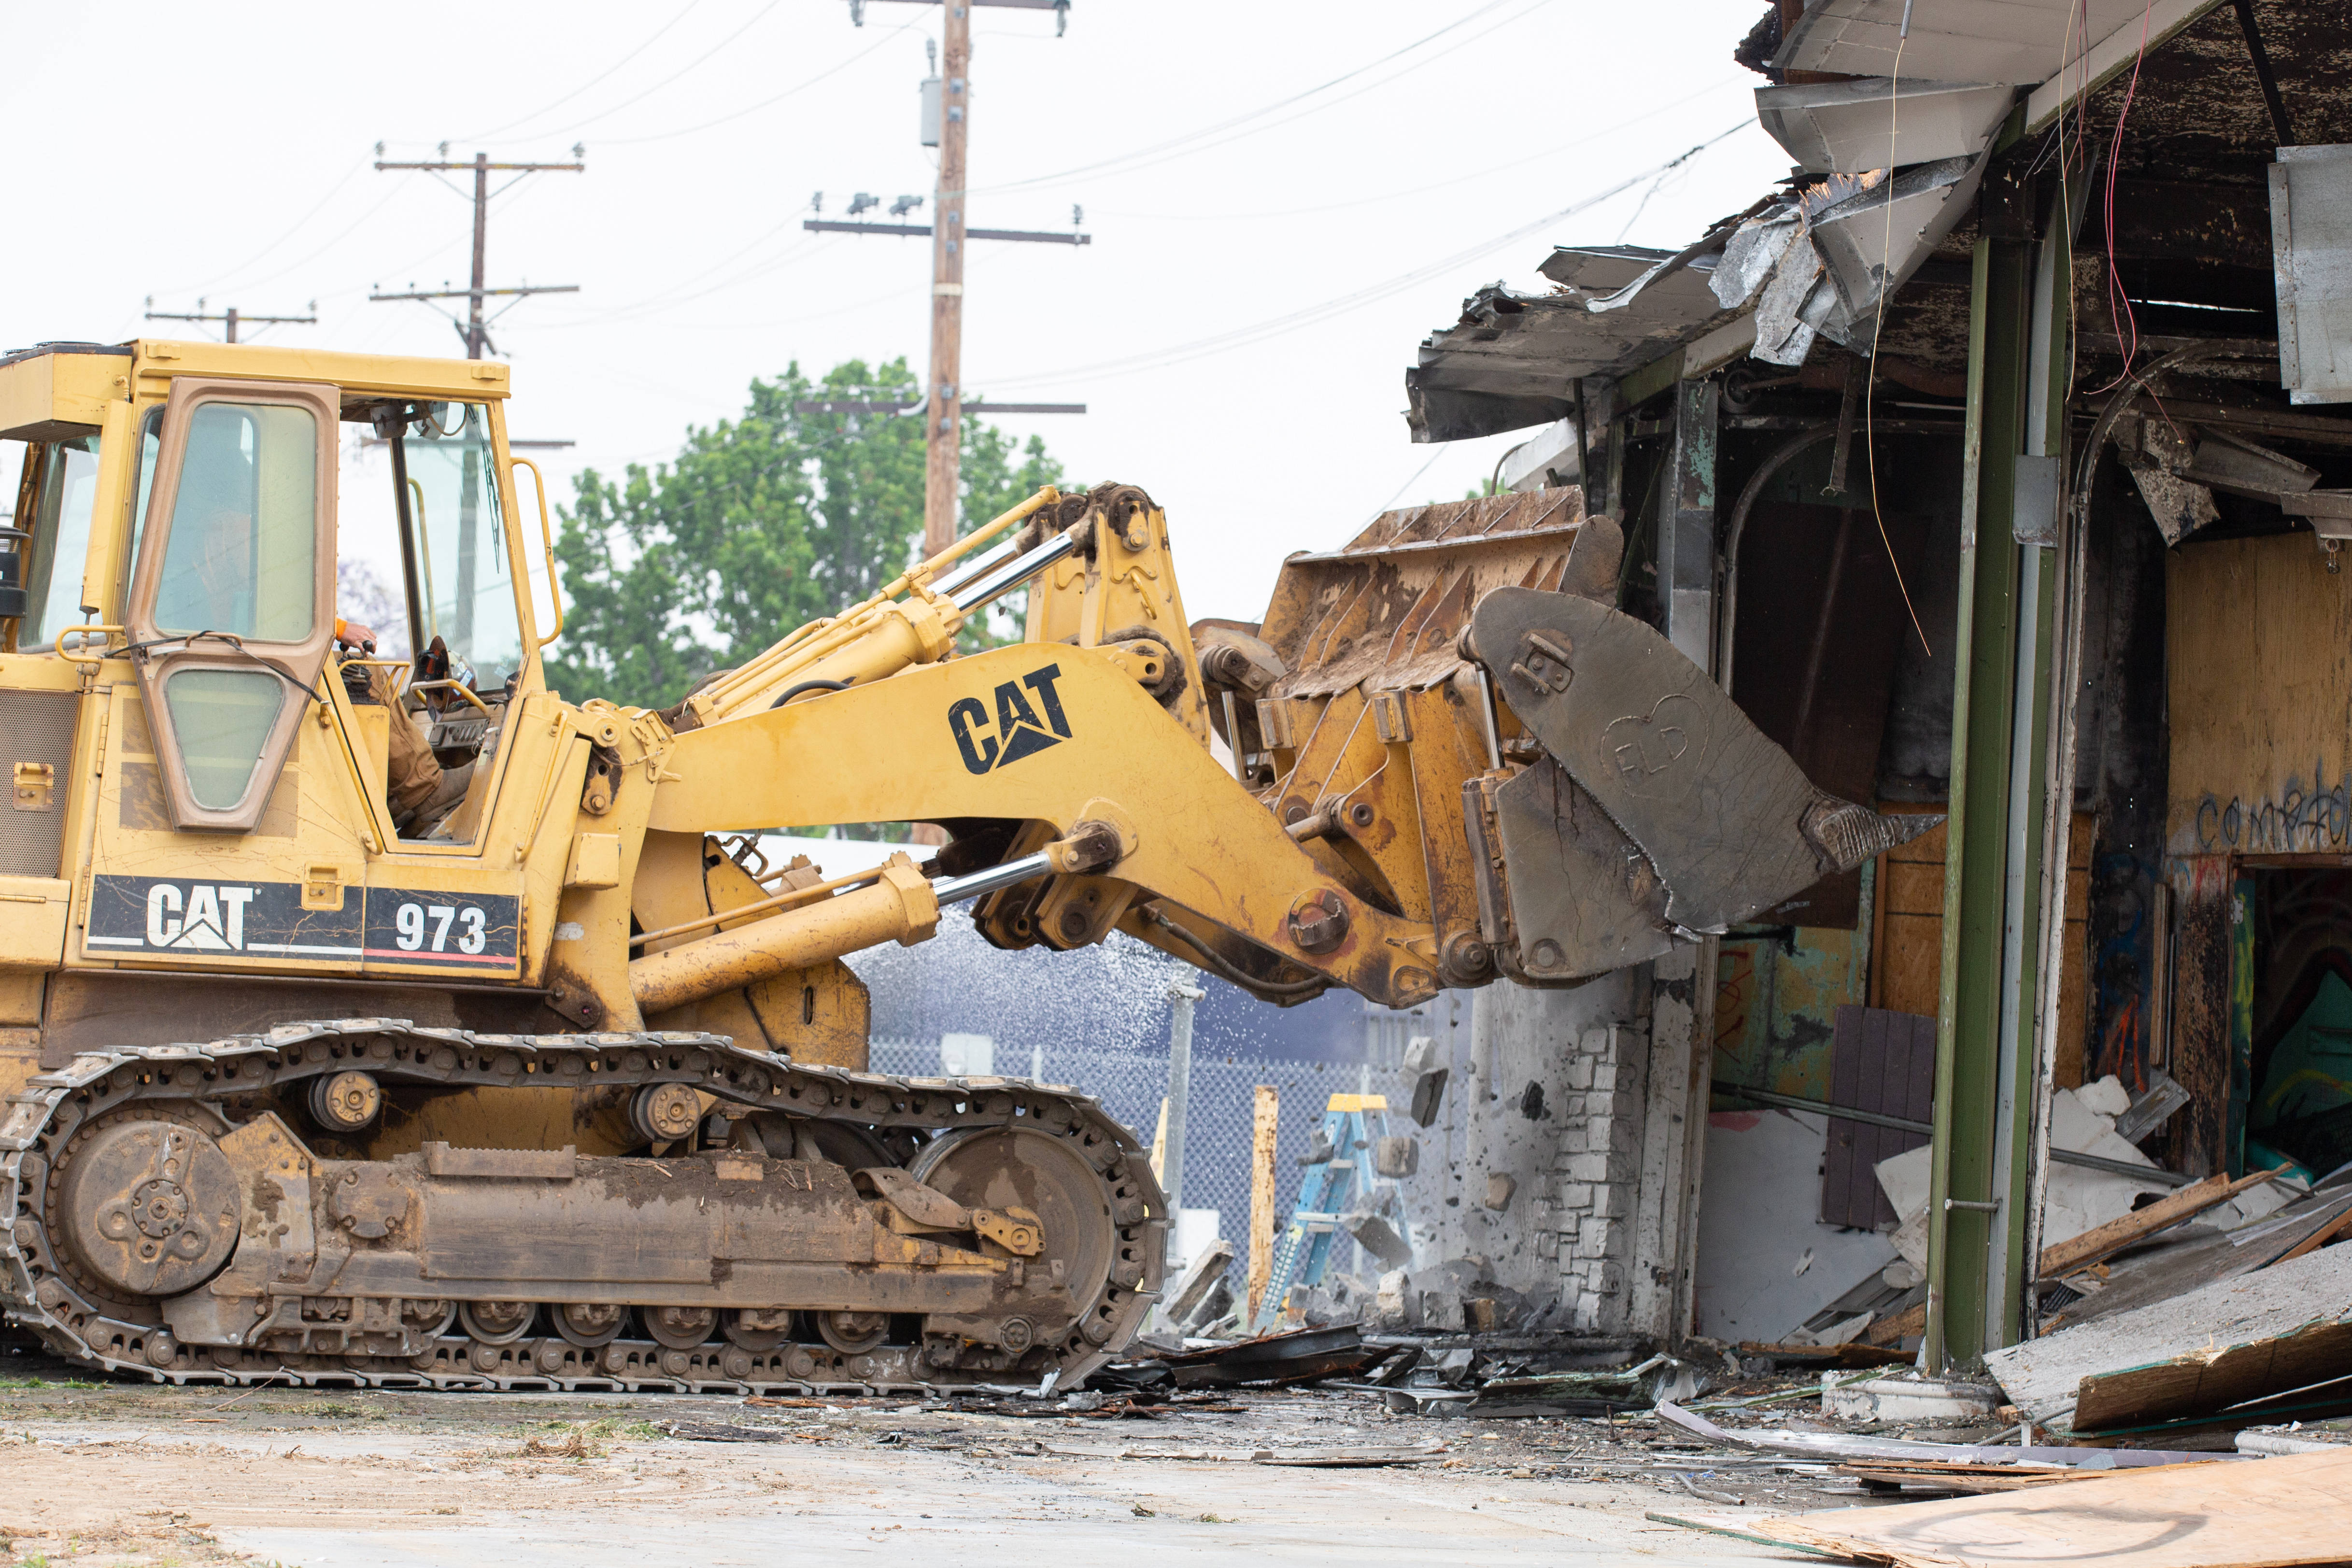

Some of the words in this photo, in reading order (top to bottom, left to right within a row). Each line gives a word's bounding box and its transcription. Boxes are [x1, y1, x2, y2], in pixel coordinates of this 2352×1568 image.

[948, 663, 1073, 775] CAT
[147, 883, 254, 950] CAT
[396, 903, 486, 954] 973
